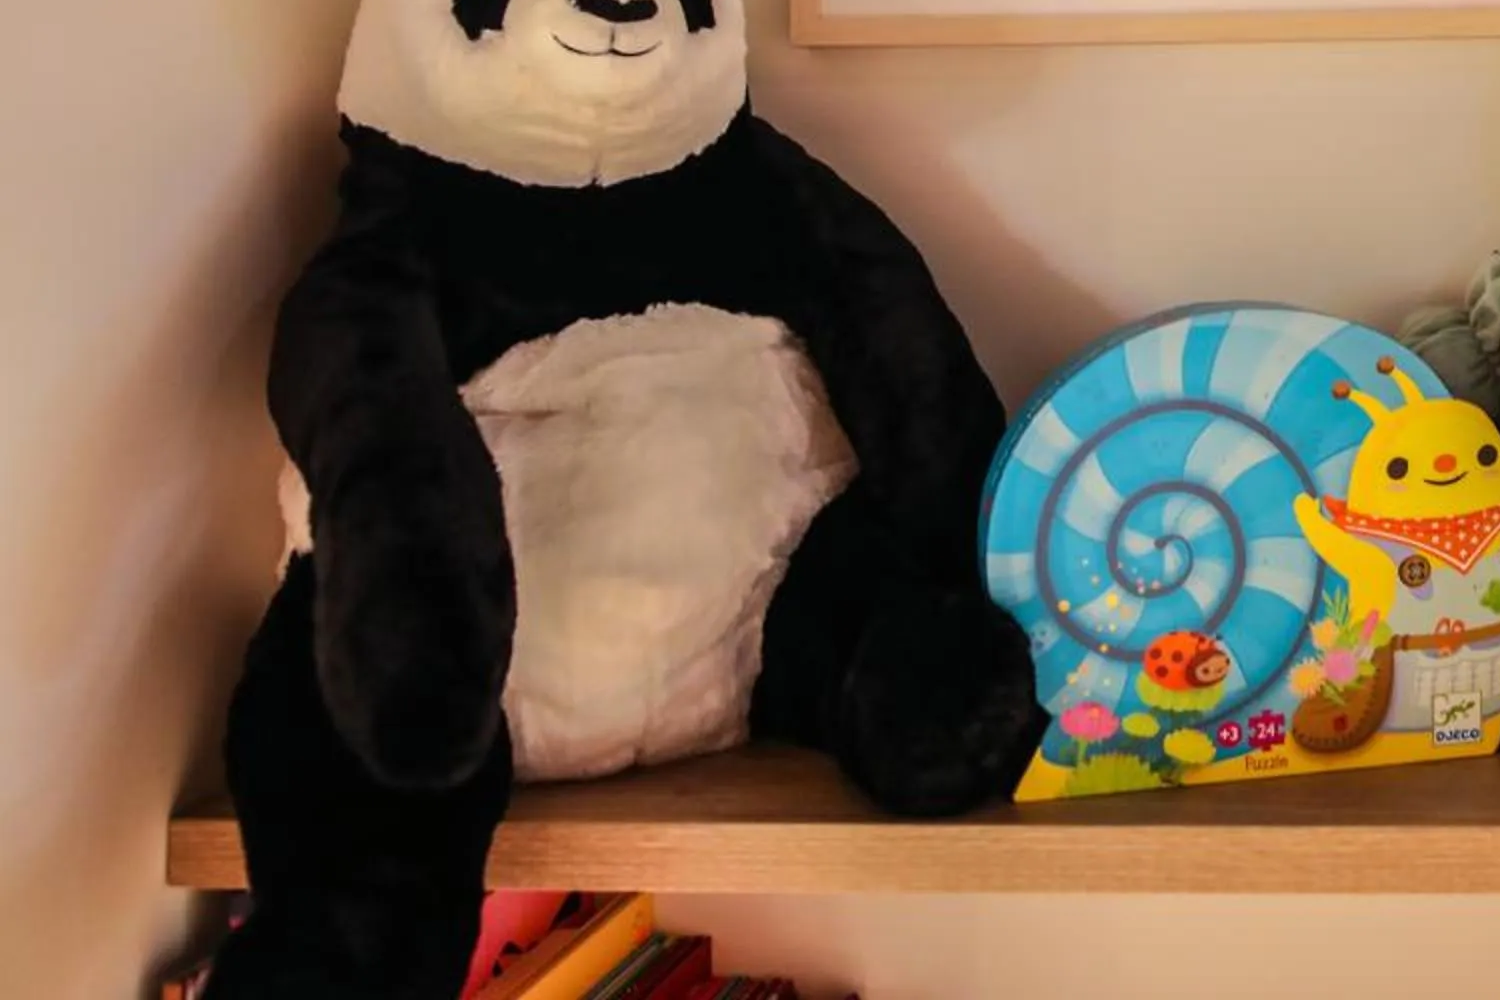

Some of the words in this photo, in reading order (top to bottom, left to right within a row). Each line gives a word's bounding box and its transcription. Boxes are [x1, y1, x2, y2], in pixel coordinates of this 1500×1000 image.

[1219, 726, 1239, 742] +3
[1436, 728, 1480, 742] DJECO
[1245, 755, 1289, 772] Puzzle
